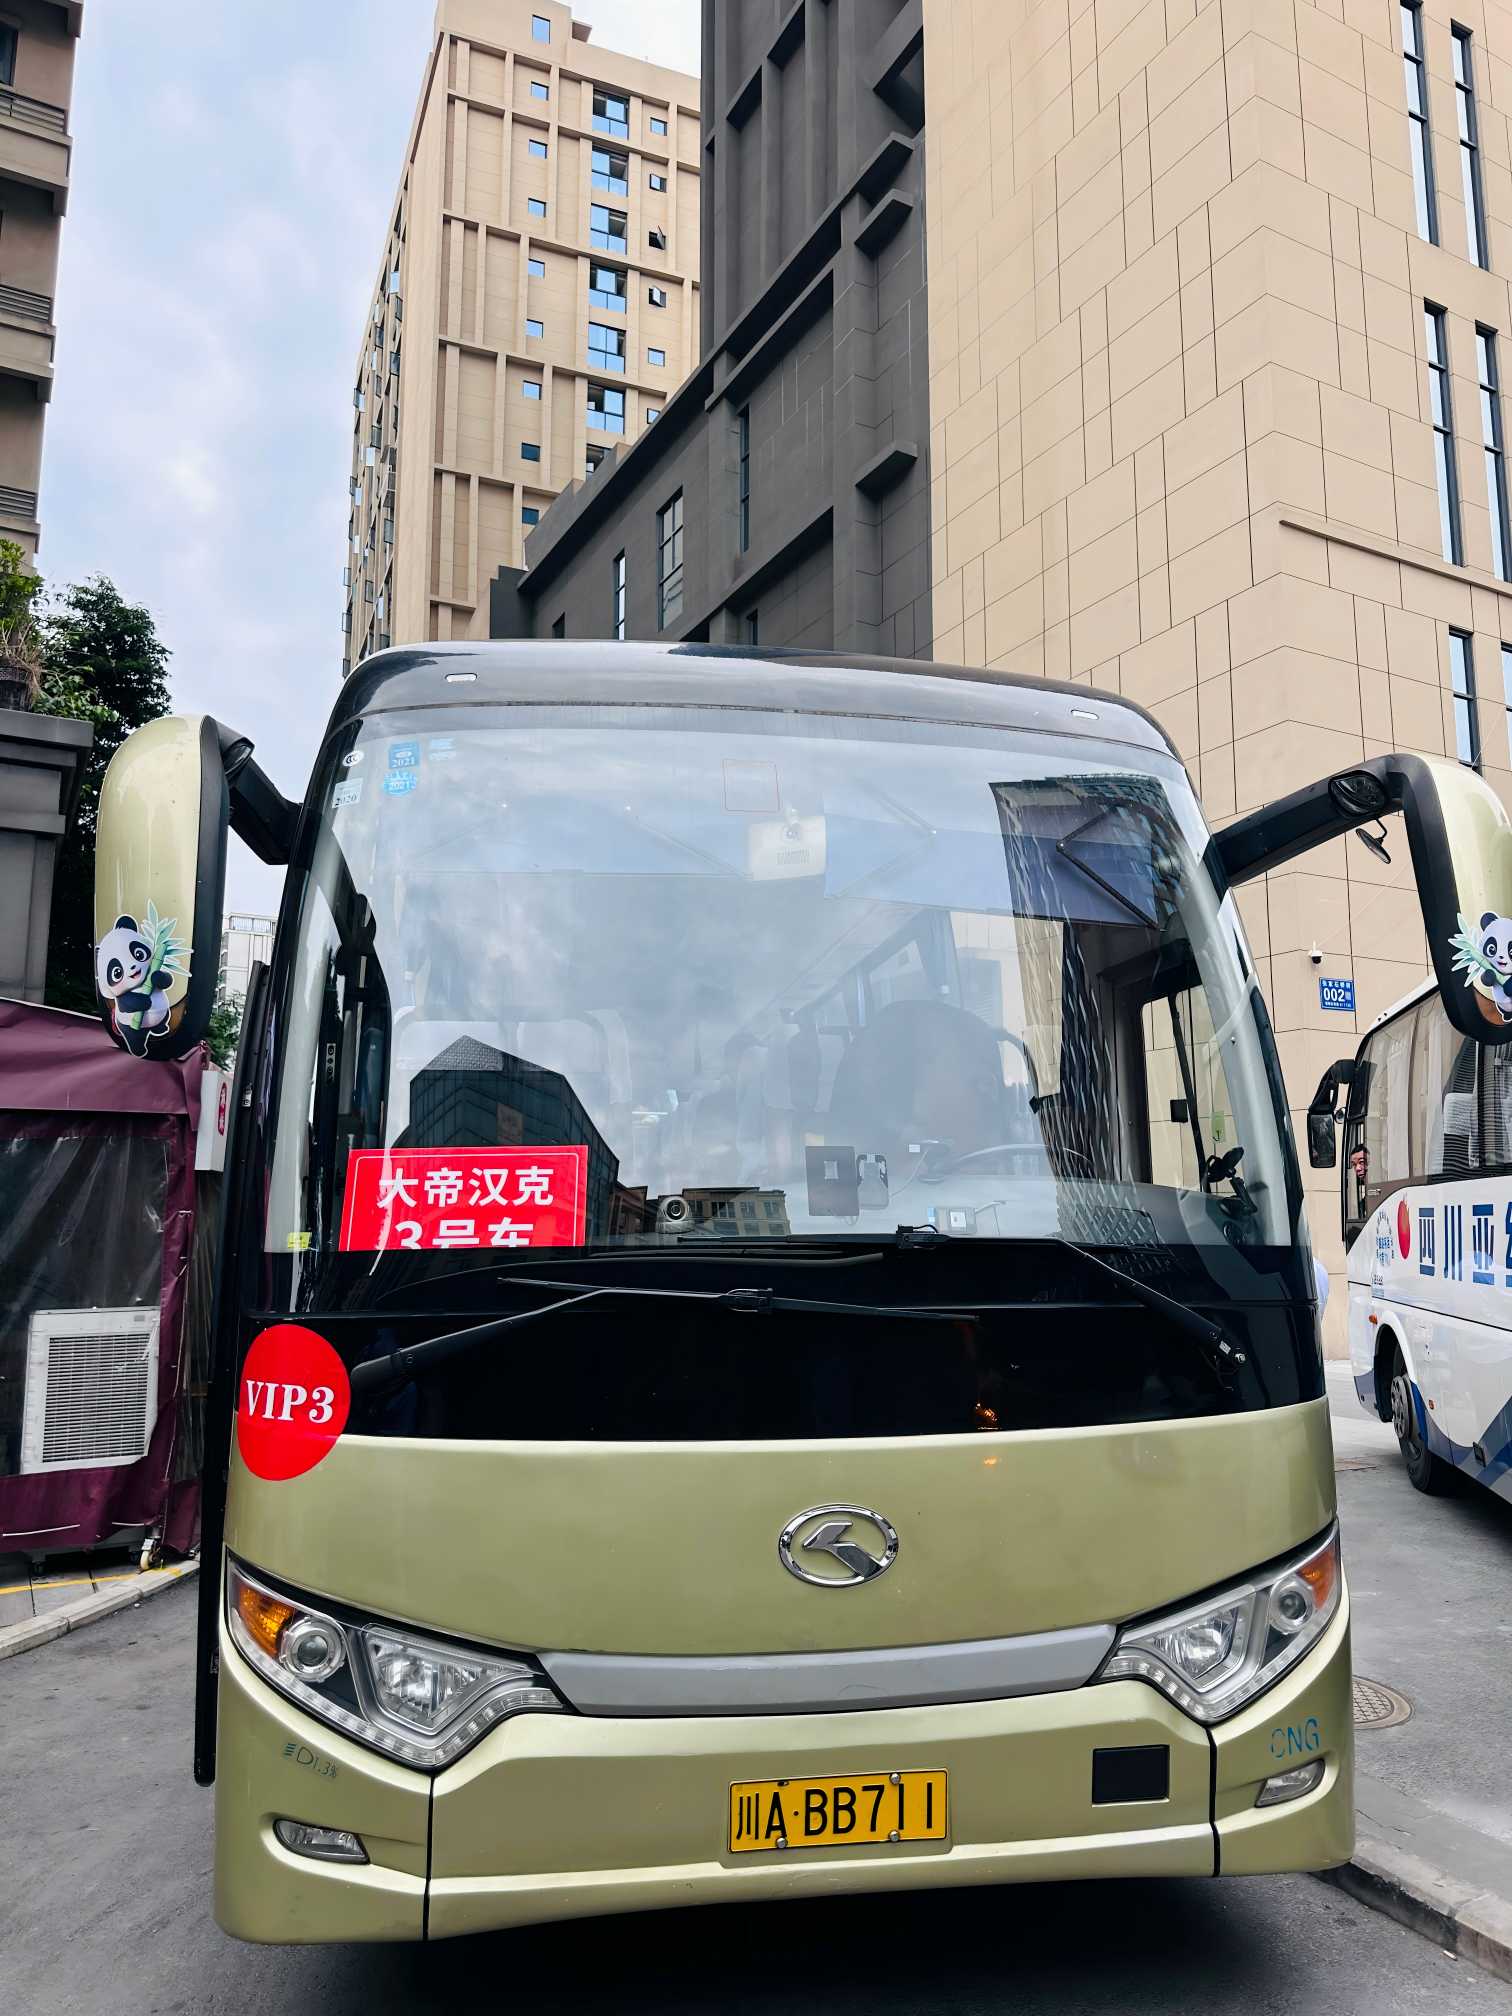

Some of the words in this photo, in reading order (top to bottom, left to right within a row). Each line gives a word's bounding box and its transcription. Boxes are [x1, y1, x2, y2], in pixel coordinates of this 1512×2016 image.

[376, 1165, 554, 1208] 大帝汉克
[395, 1217, 534, 1249] 3号车
[246, 1380, 335, 1424] VIP3
[1271, 1718, 1320, 1758] CNG
